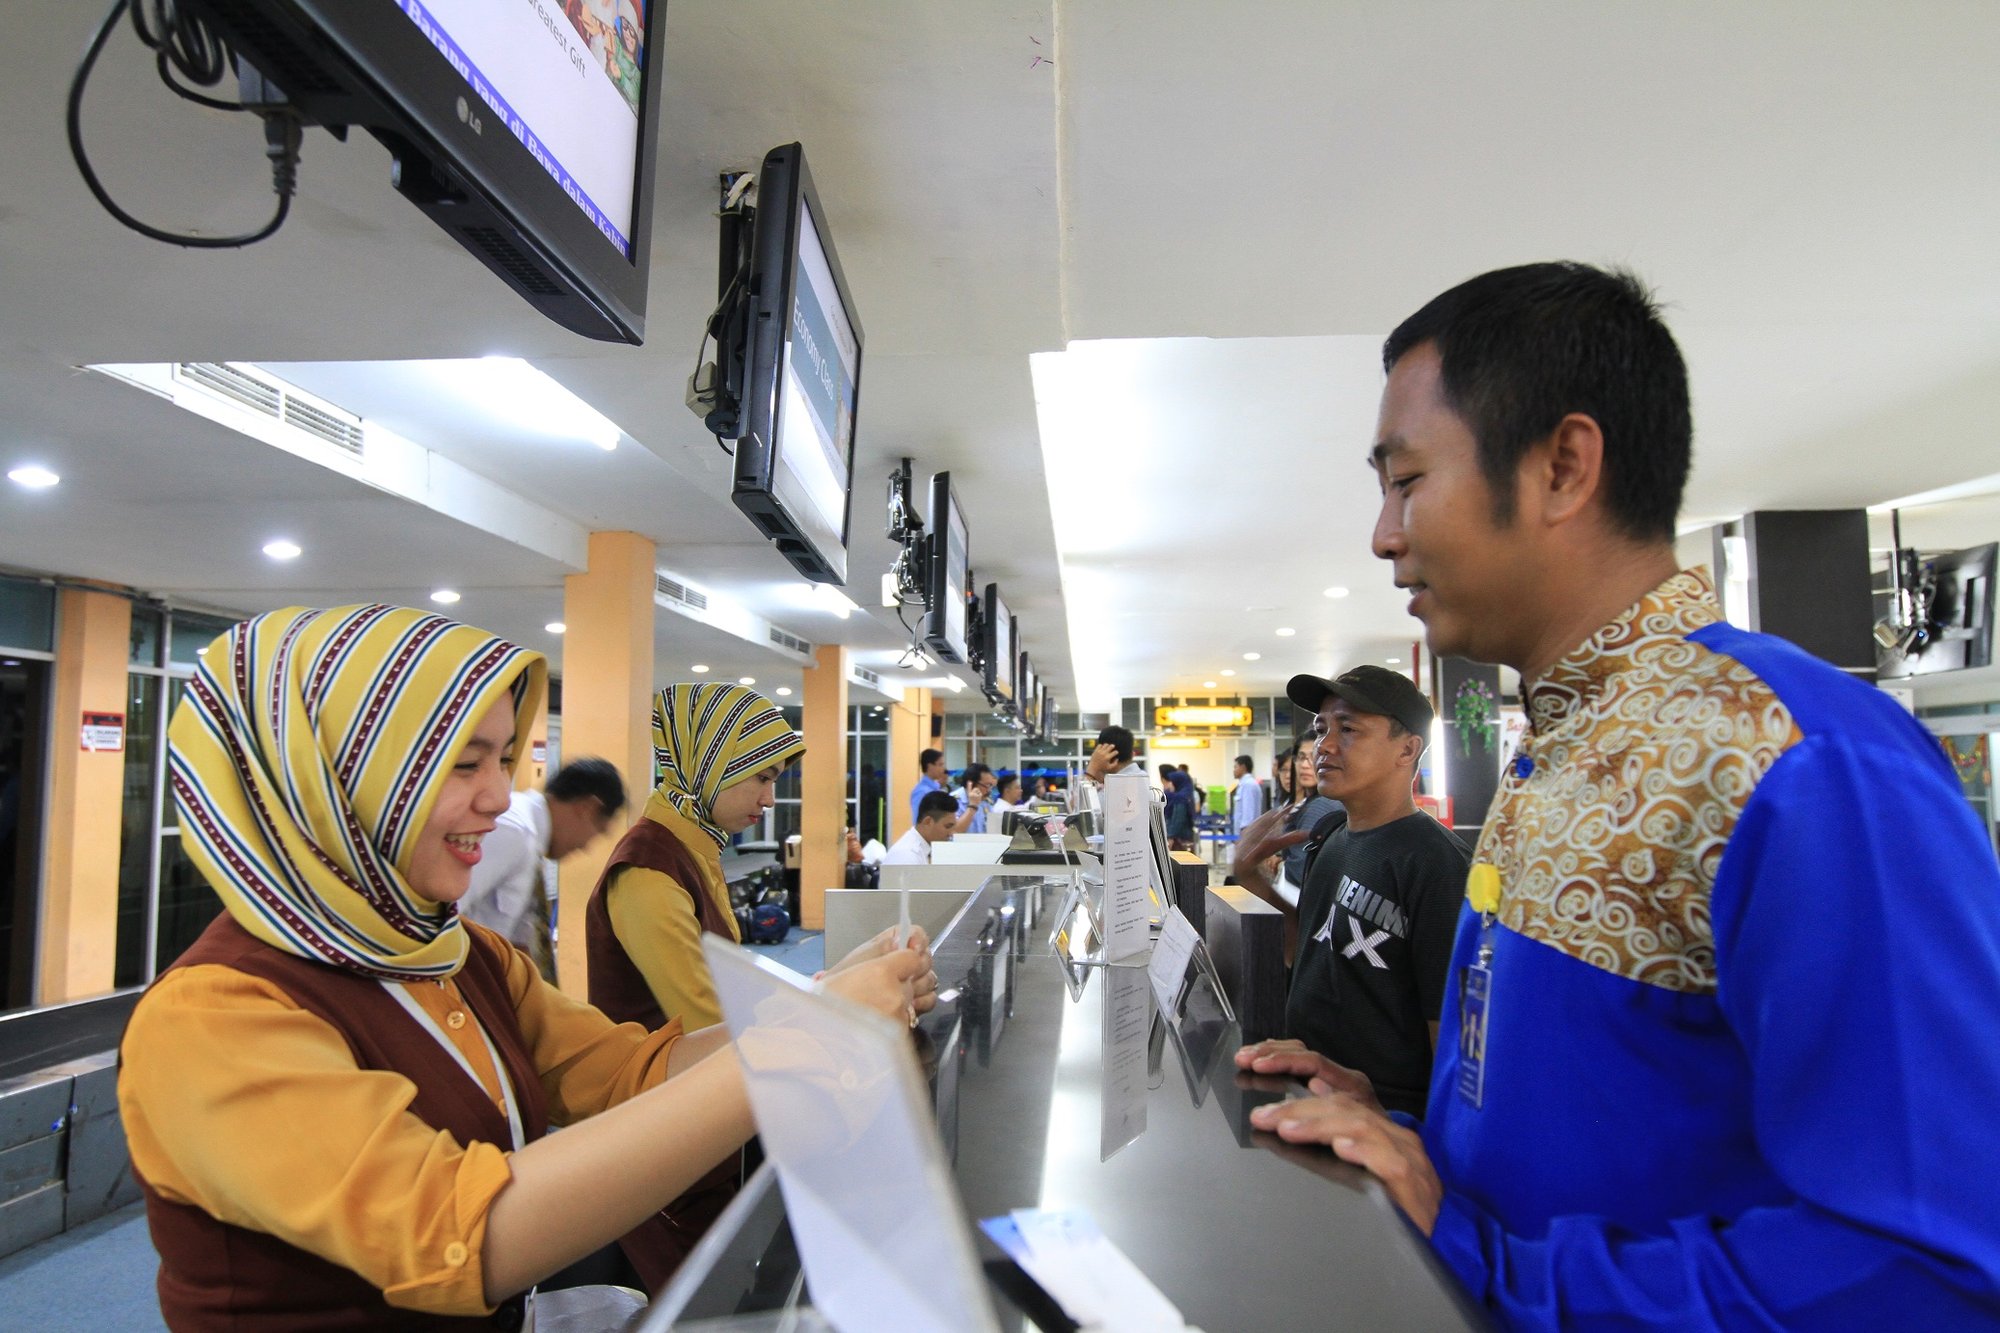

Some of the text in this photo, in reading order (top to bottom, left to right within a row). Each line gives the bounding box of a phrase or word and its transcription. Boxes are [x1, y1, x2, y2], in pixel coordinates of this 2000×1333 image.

[569, 46, 586, 79] Gift
[406, 0, 470, 82] Barang
[510, 120, 525, 145] di
[527, 134, 560, 184] Bawa
[563, 178, 596, 223] dalam
[598, 215, 626, 257] Kabin
[469, 110, 482, 136] LG
[793, 295, 834, 401] Economy Class
